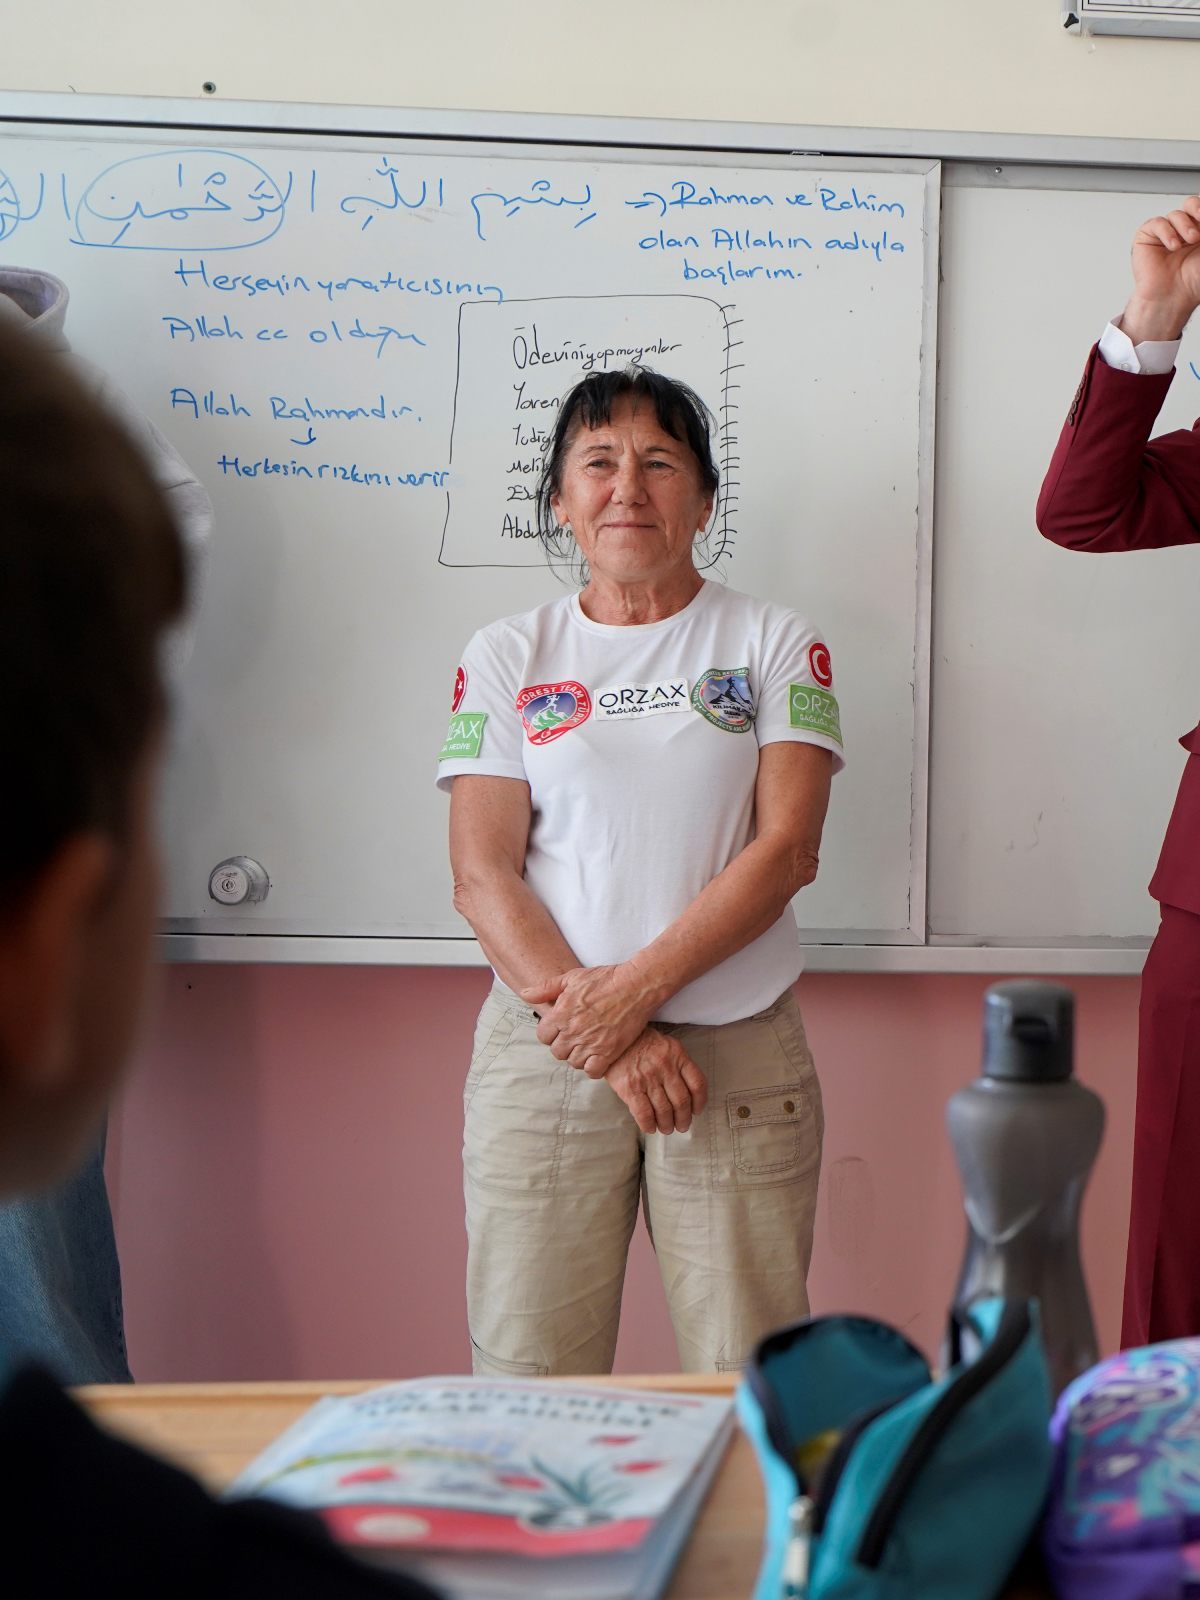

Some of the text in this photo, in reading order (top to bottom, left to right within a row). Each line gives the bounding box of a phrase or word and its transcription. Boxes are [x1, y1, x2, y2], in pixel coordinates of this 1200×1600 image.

[784, 192, 815, 207] ve
[638, 226, 907, 263] olan Allahın adıyla
[159, 313, 244, 341] Allah
[169, 385, 252, 418] Allah
[517, 684, 589, 723] FOREST TEAM TÜRK
[599, 684, 686, 707] ORZAX
[792, 692, 839, 719] ORZ
[606, 706, 645, 715] SAĞLIĞA
